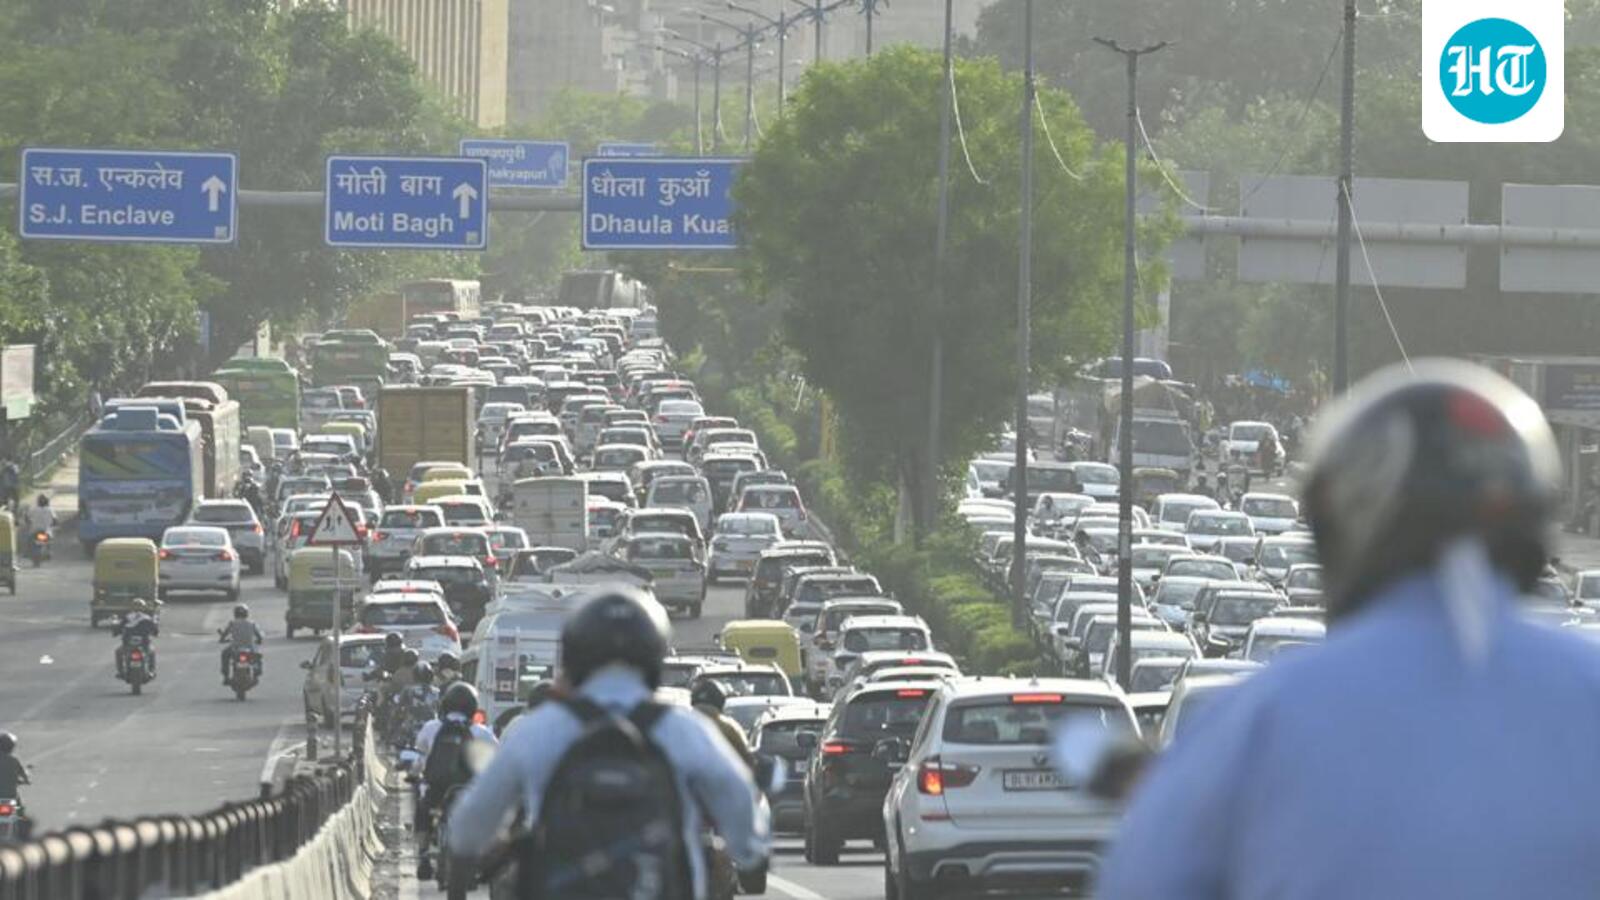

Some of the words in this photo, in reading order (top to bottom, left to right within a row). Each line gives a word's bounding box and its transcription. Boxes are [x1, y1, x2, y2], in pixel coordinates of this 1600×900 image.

[30, 165, 88, 188] स.ज.
[98, 162, 183, 192] एन्कलेव
[335, 165, 387, 195] मोती
[400, 175, 442, 196] बाग
[489, 168, 548, 181] nakyapuri
[591, 168, 646, 198] धौला
[657, 169, 711, 206] कुआँ
[29, 203, 73, 225] S.J.
[80, 204, 175, 225] Enclave
[334, 211, 384, 232] Moti
[392, 212, 454, 238] Bagh
[590, 212, 674, 235] Dhaula
[682, 213, 735, 235] Kua
